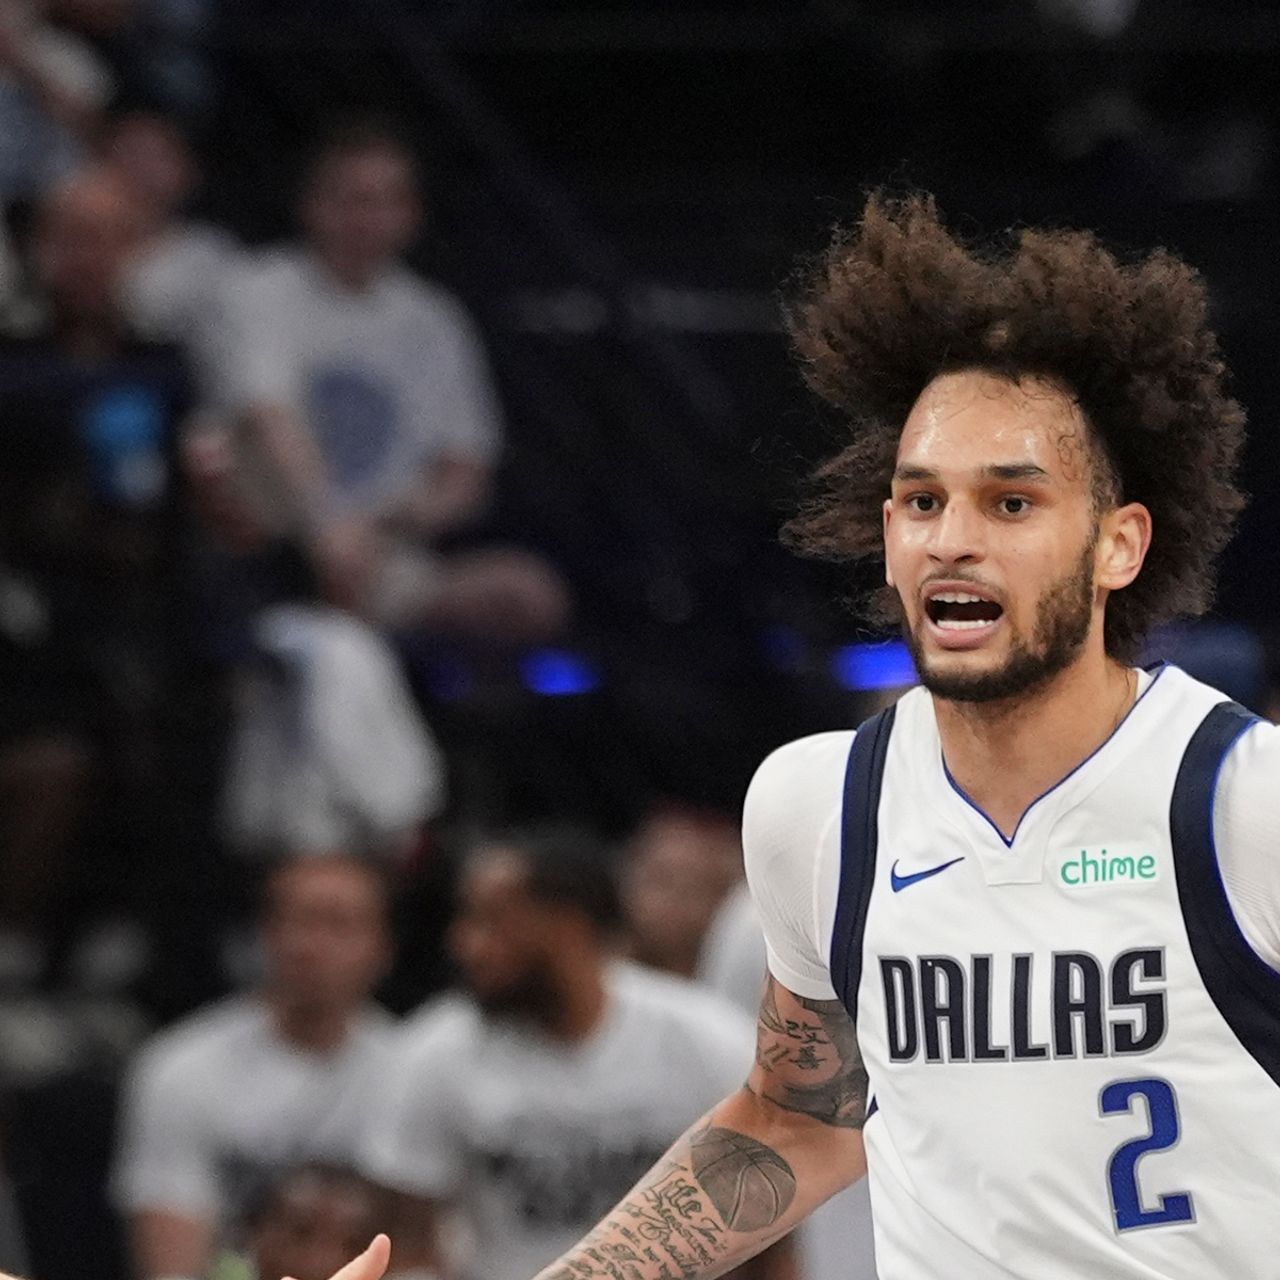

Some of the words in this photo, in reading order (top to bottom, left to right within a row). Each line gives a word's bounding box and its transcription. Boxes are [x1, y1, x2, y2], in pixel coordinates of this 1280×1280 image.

[1060, 849, 1157, 885] chime
[877, 945, 1169, 1064] DALLAS
[1098, 1075, 1198, 1236] 2
